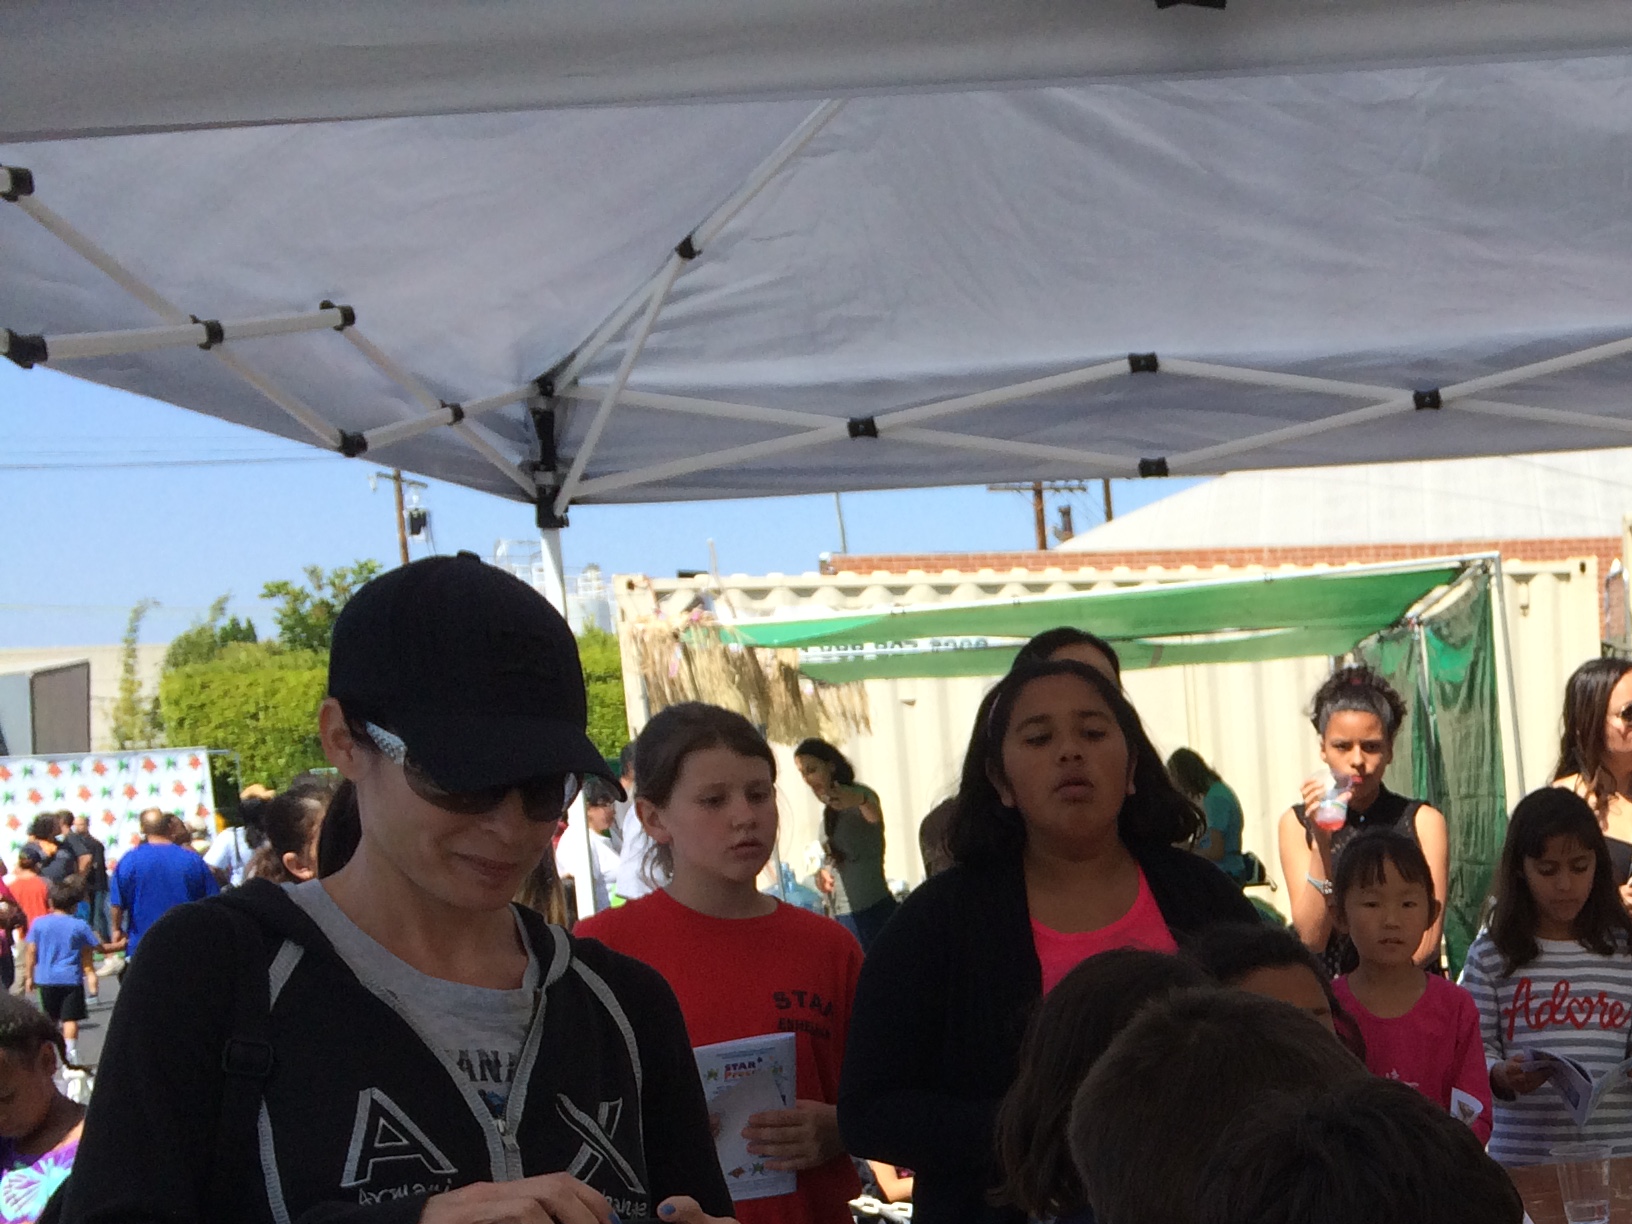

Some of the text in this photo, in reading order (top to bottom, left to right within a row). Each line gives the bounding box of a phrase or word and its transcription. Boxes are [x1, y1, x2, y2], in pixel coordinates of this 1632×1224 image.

[1503, 977, 1632, 1041] Adore
[724, 1060, 757, 1071] STAR
[340, 1086, 647, 1195] A X
